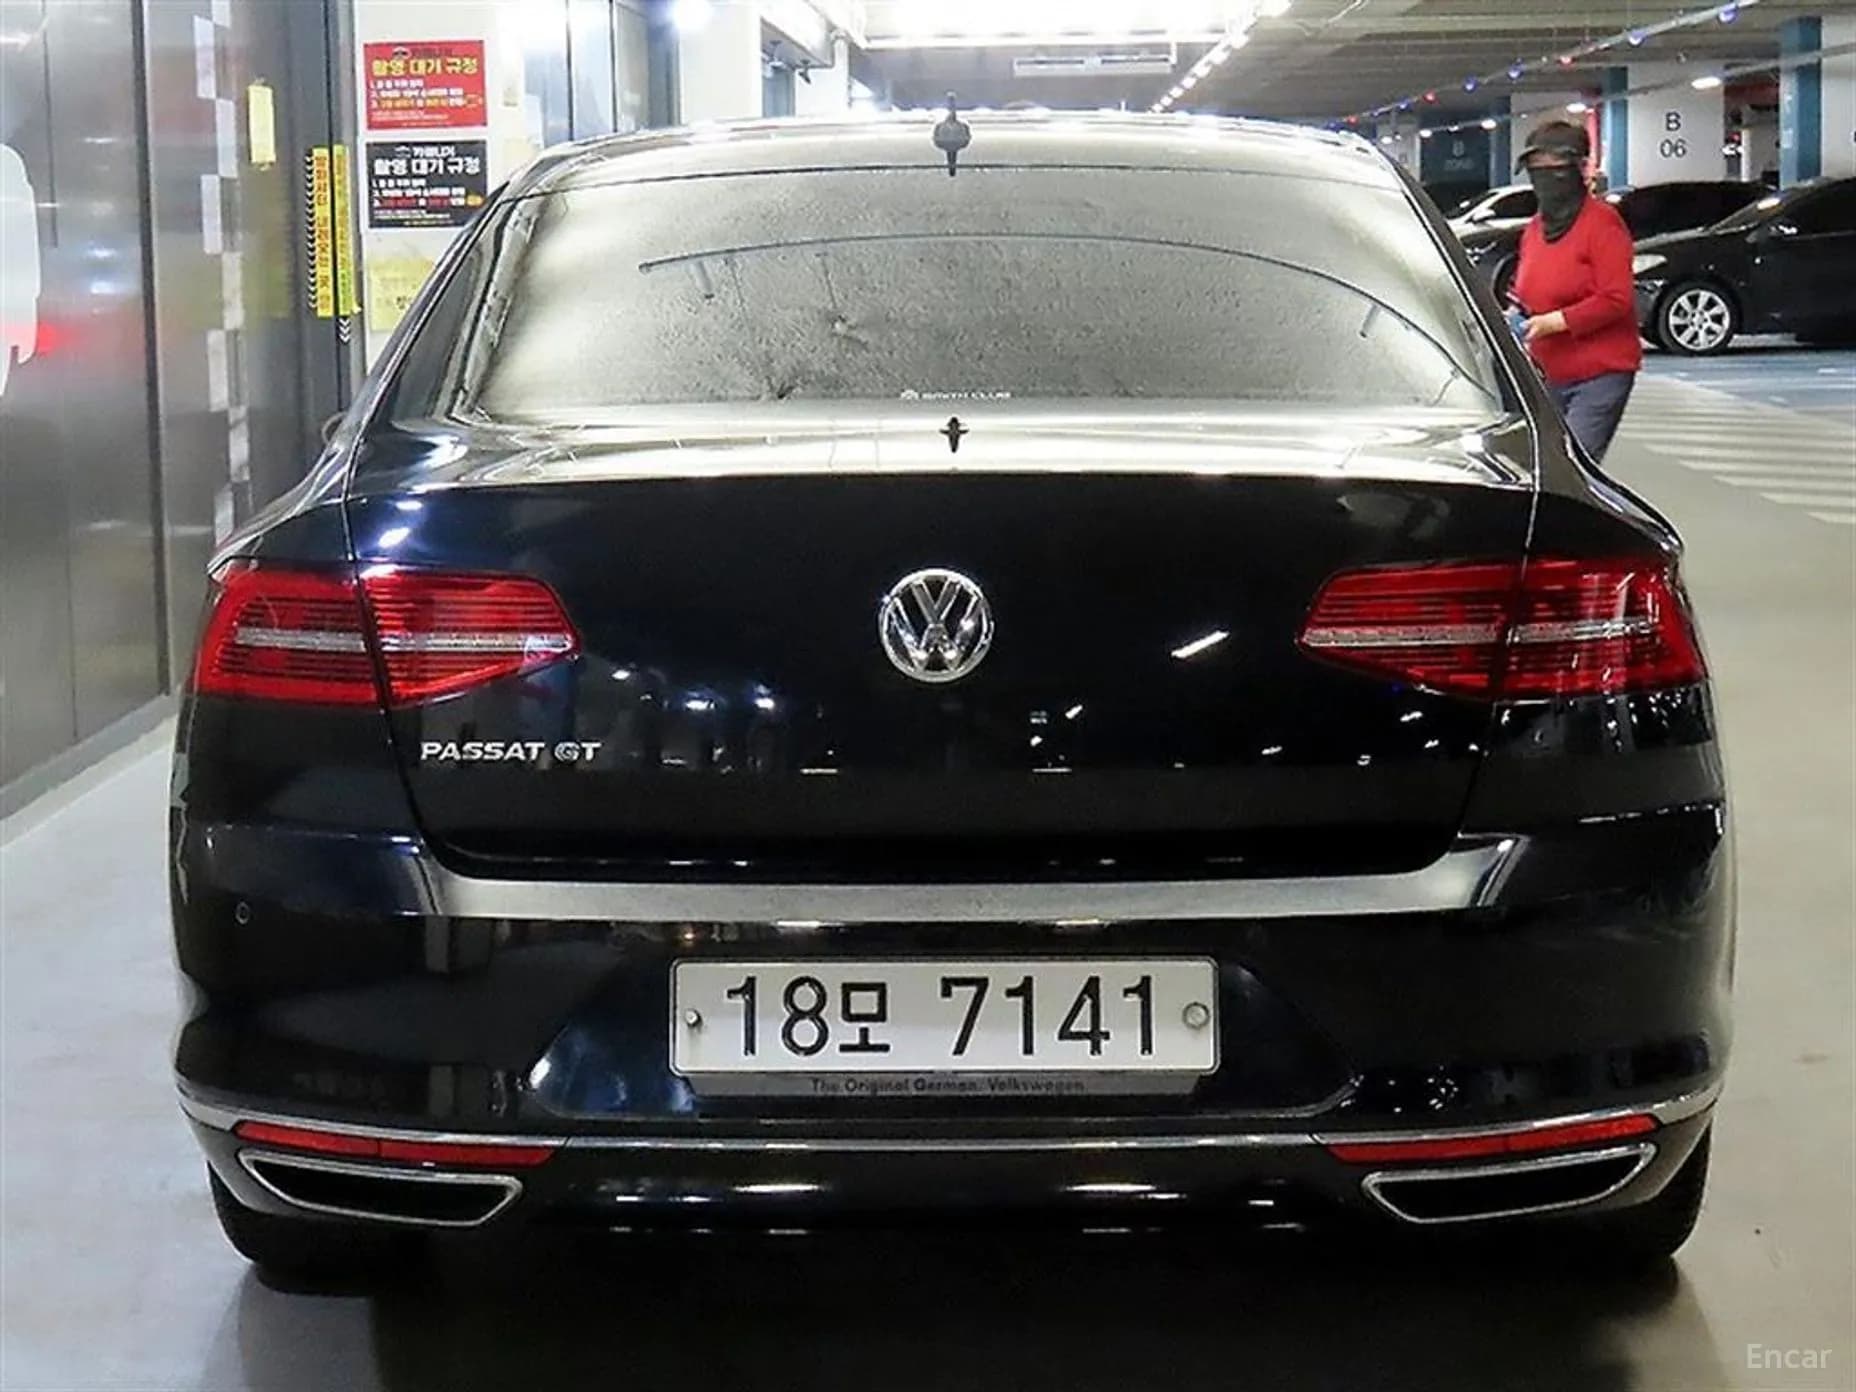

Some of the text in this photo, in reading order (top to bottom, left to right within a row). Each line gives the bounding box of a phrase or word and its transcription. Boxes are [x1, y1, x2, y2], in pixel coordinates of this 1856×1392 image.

[409, 58, 442, 76] 대기
[445, 57, 478, 75] 규정
[1665, 111, 1681, 131] B
[1660, 139, 1687, 158] 06
[411, 158, 444, 176] 대기
[447, 157, 480, 175] 규정
[420, 741, 602, 762] PASSAT GT
[726, 974, 1154, 1057] 18모 7141
